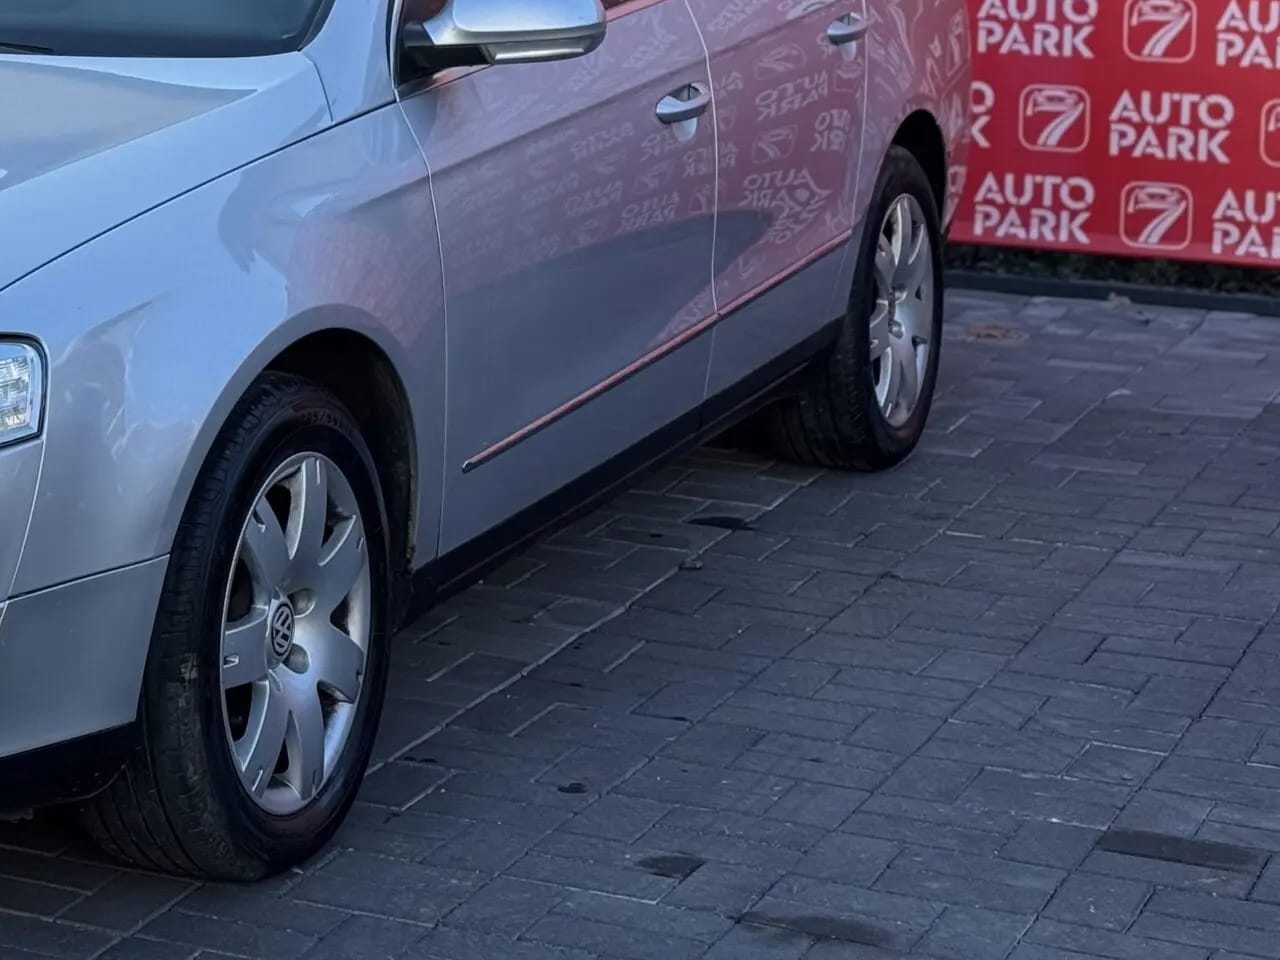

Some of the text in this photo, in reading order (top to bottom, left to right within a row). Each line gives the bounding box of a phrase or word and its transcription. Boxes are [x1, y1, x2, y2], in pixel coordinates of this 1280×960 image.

[978, 21, 1094, 58] PARK
[1109, 90, 1234, 128] AUTO
[1109, 122, 1230, 163] PARK
[974, 173, 1094, 210] AUTO
[973, 204, 1090, 245] PARK
